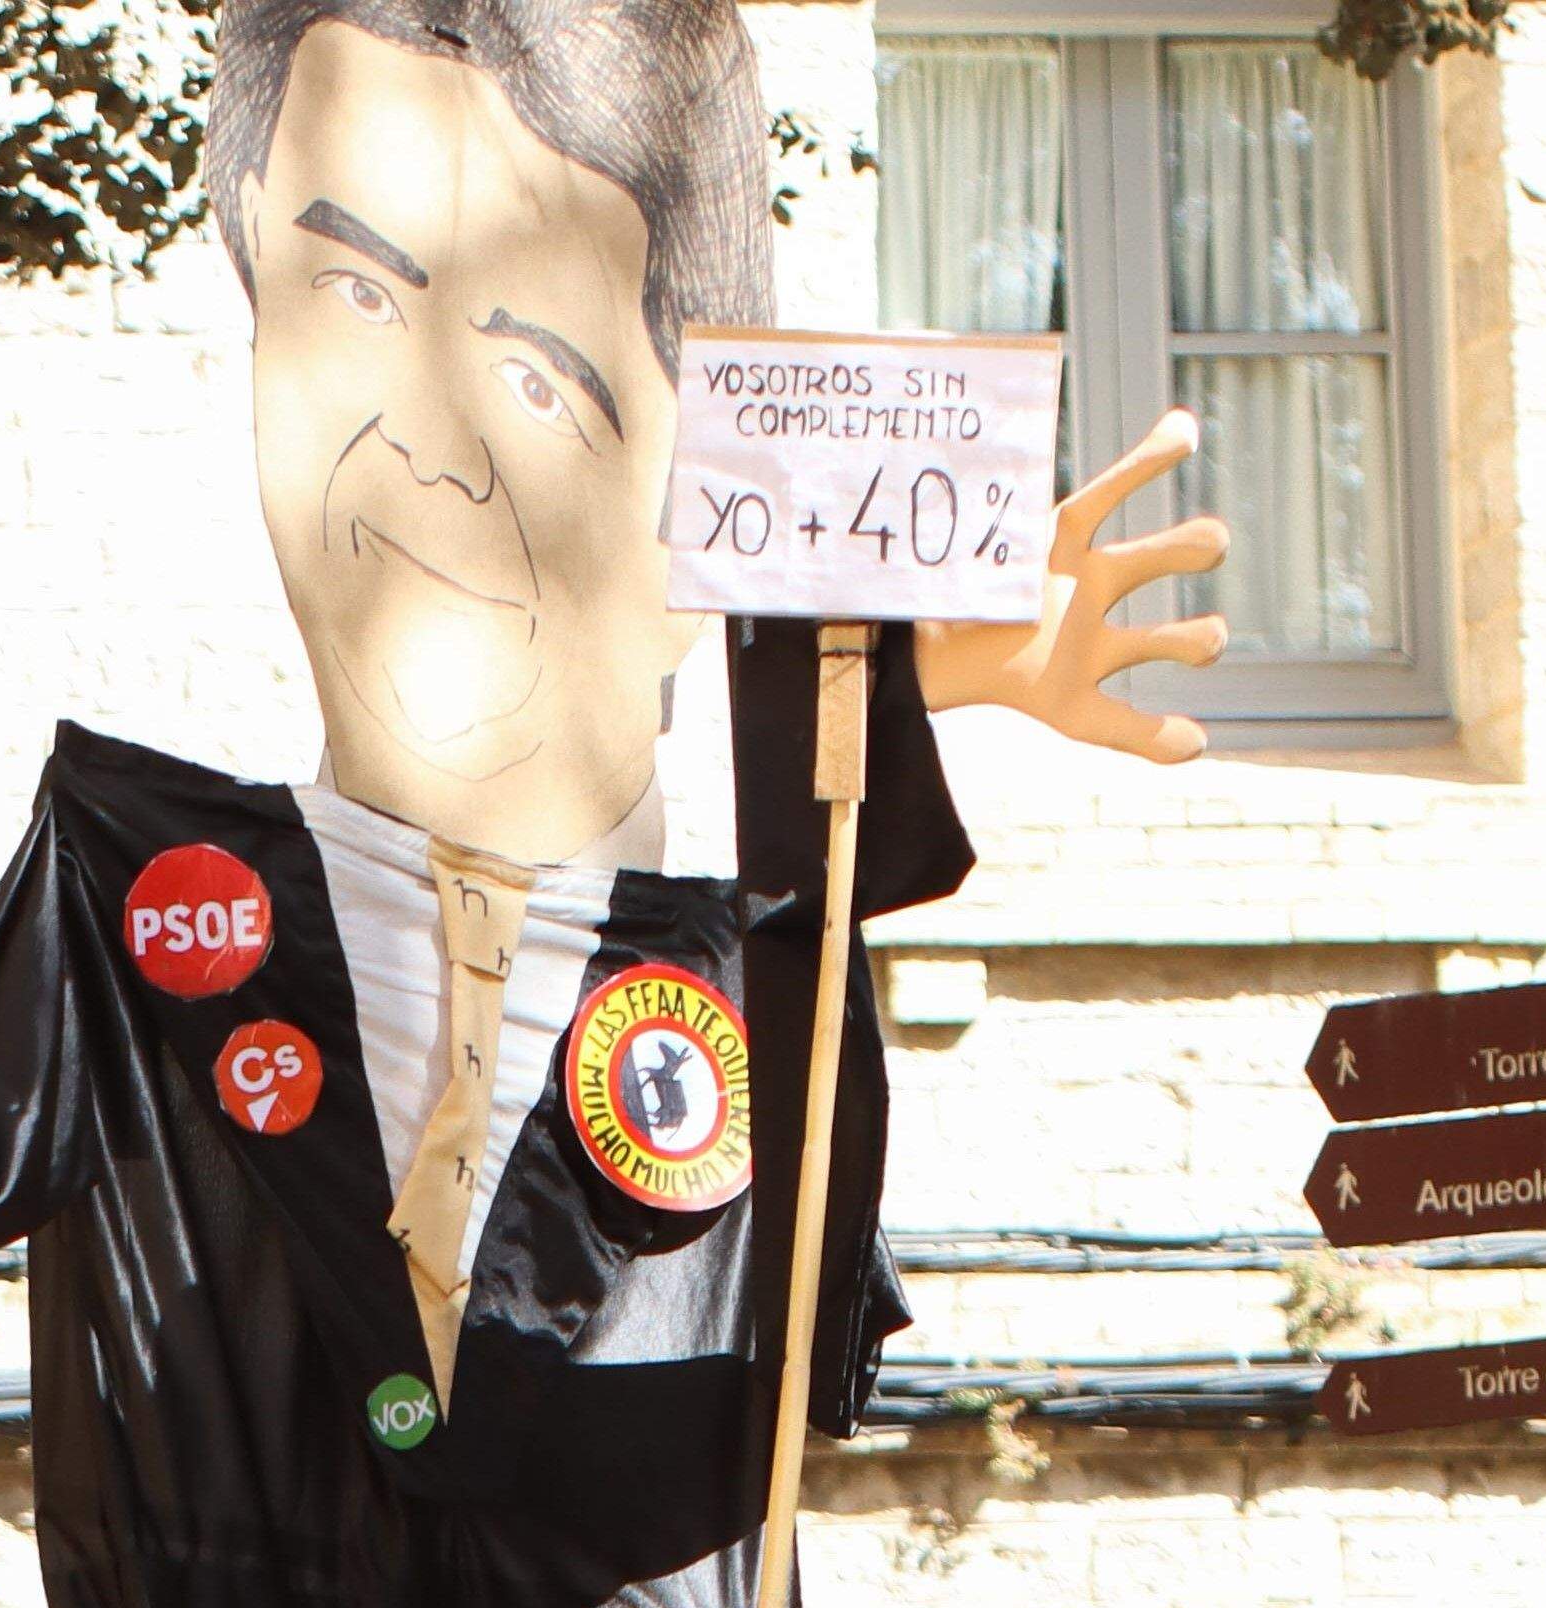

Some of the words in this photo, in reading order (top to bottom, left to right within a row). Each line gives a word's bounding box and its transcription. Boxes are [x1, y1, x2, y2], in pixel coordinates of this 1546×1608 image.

[703, 362, 873, 398] VOSOTROS
[904, 369, 967, 399] SIN
[736, 402, 983, 441] COMPLEMENTO
[699, 483, 773, 557] YO
[132, 898, 263, 957] PSOE
[625, 981, 688, 1022] FFAA
[691, 997, 723, 1041] TE
[588, 997, 628, 1053] LAS
[231, 1044, 303, 1094] Cs
[581, 1062, 632, 1169] MUCHO
[630, 1155, 728, 1197] MUCHO
[1459, 1360, 1541, 1402] Torre
[373, 1392, 437, 1437] VOX
